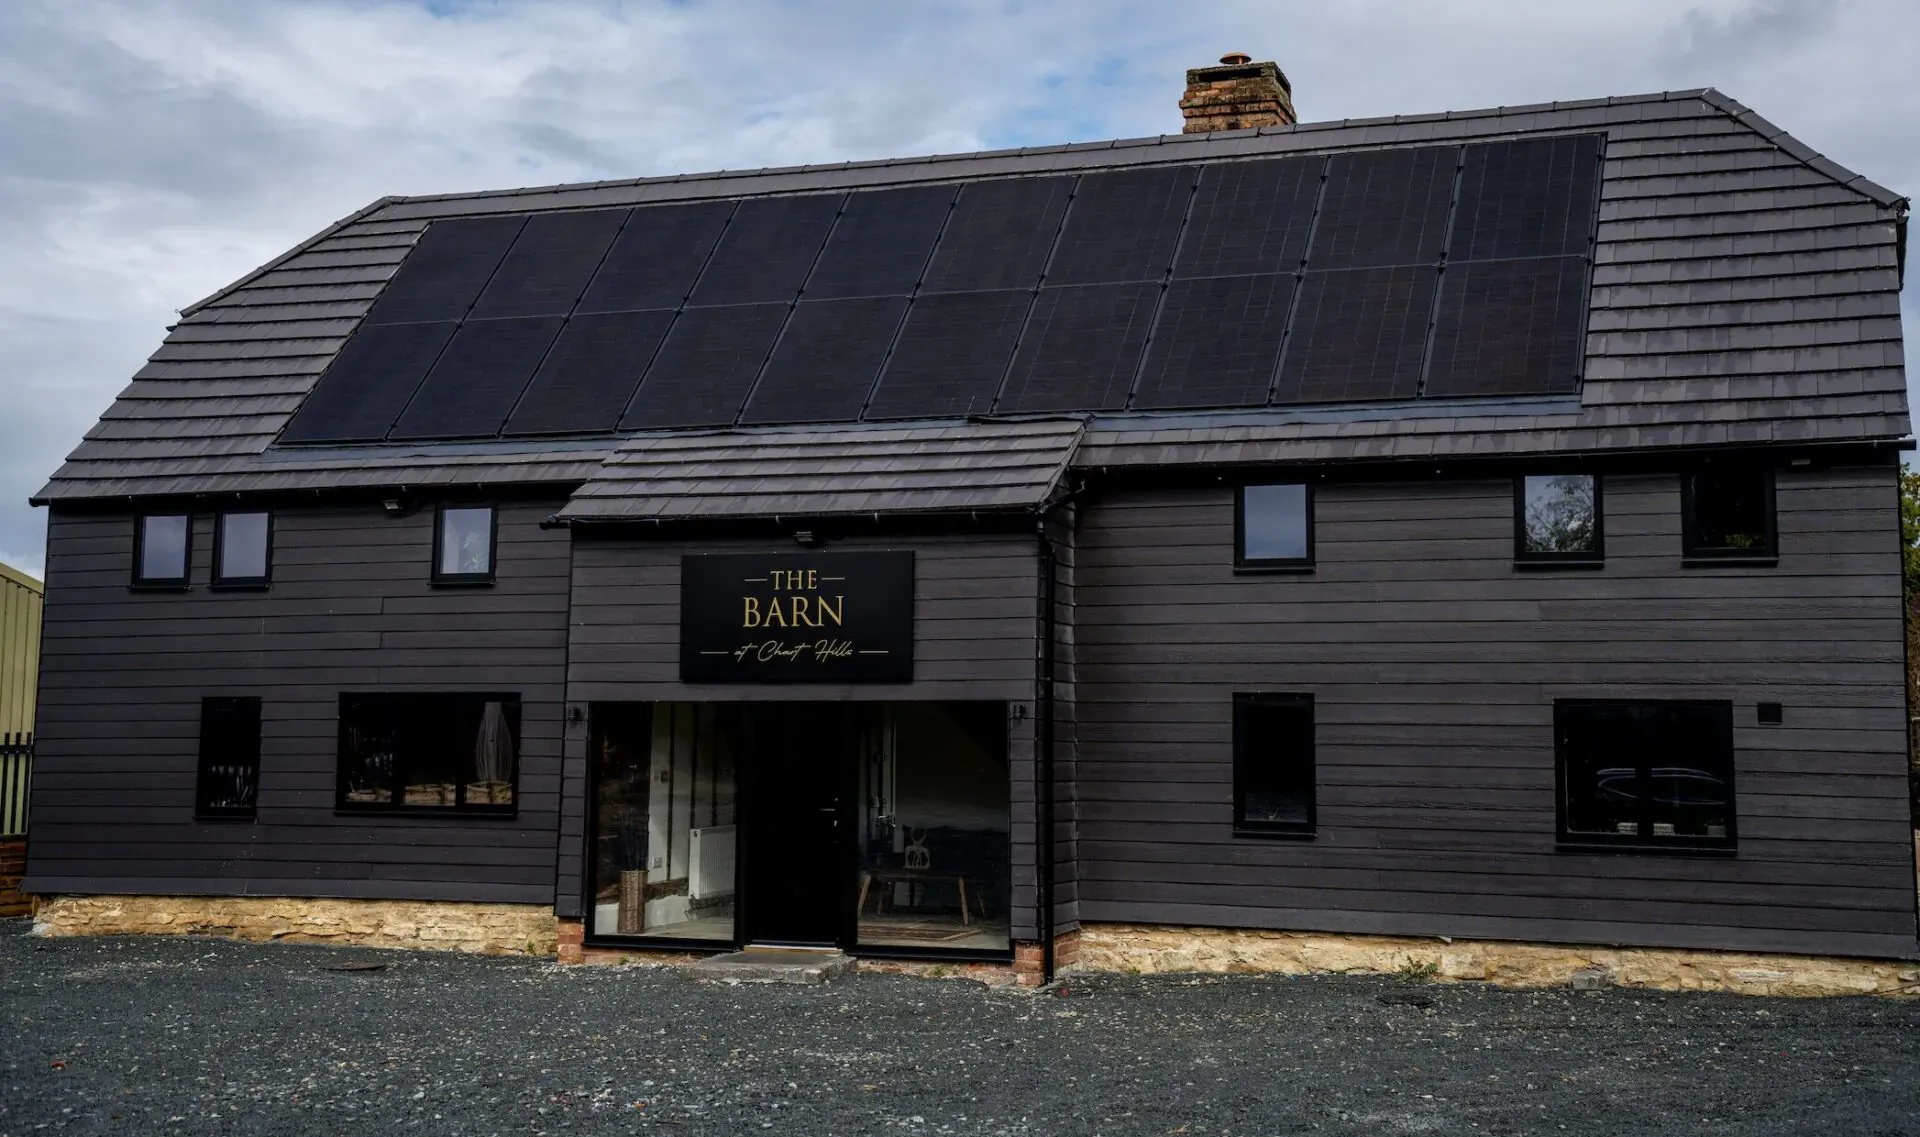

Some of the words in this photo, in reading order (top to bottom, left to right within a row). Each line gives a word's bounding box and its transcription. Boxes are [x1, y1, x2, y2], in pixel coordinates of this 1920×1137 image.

[770, 570, 818, 590] THE
[742, 595, 845, 628] BARN
[734, 642, 758, 662] at
[757, 640, 811, 662] Chart
[814, 639, 853, 663] Hills
